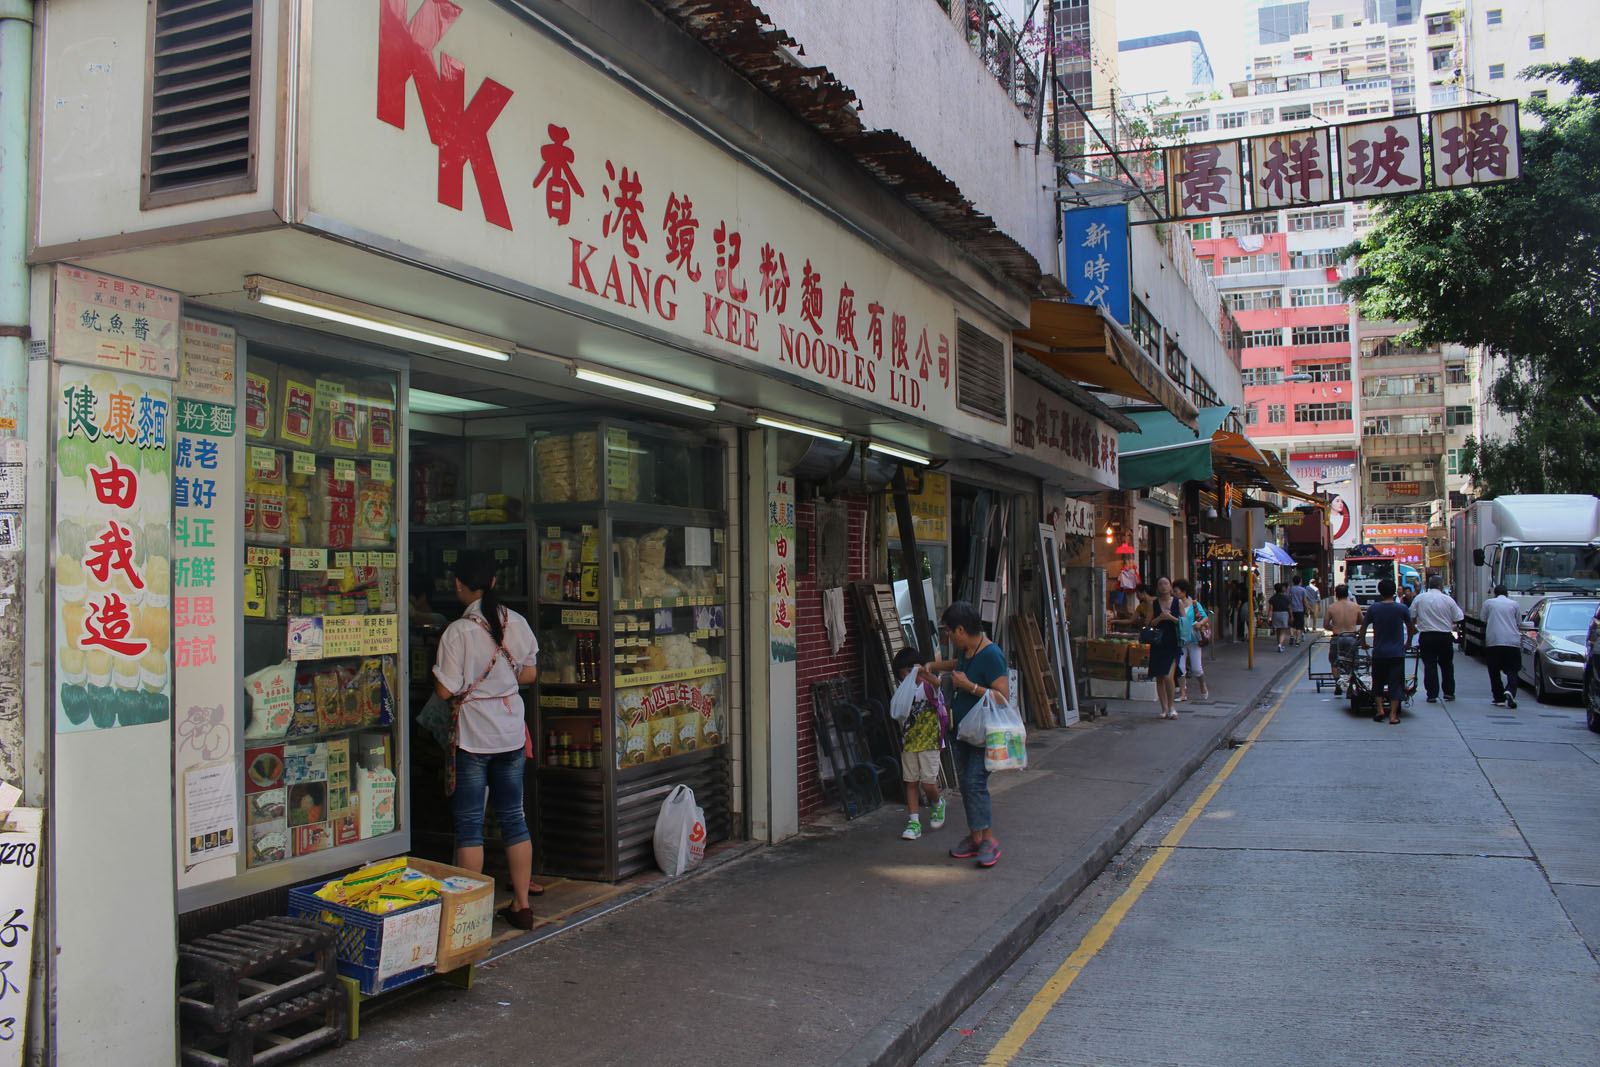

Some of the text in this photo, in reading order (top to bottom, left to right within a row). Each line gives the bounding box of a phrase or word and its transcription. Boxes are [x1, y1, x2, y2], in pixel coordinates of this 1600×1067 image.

[1174, 112, 1510, 212] 景祥玻璃
[533, 123, 950, 389] 香港鏡記粉麵廠有限公司
[80, 309, 150, 342] 魷魚醬
[97, 344, 157, 372] 二十元
[568, 237, 926, 412] KANG KEE NOODLES LTD.
[64, 384, 168, 449] 健康麵
[176, 402, 233, 434] 粉麵
[81, 455, 147, 657] 由我造
